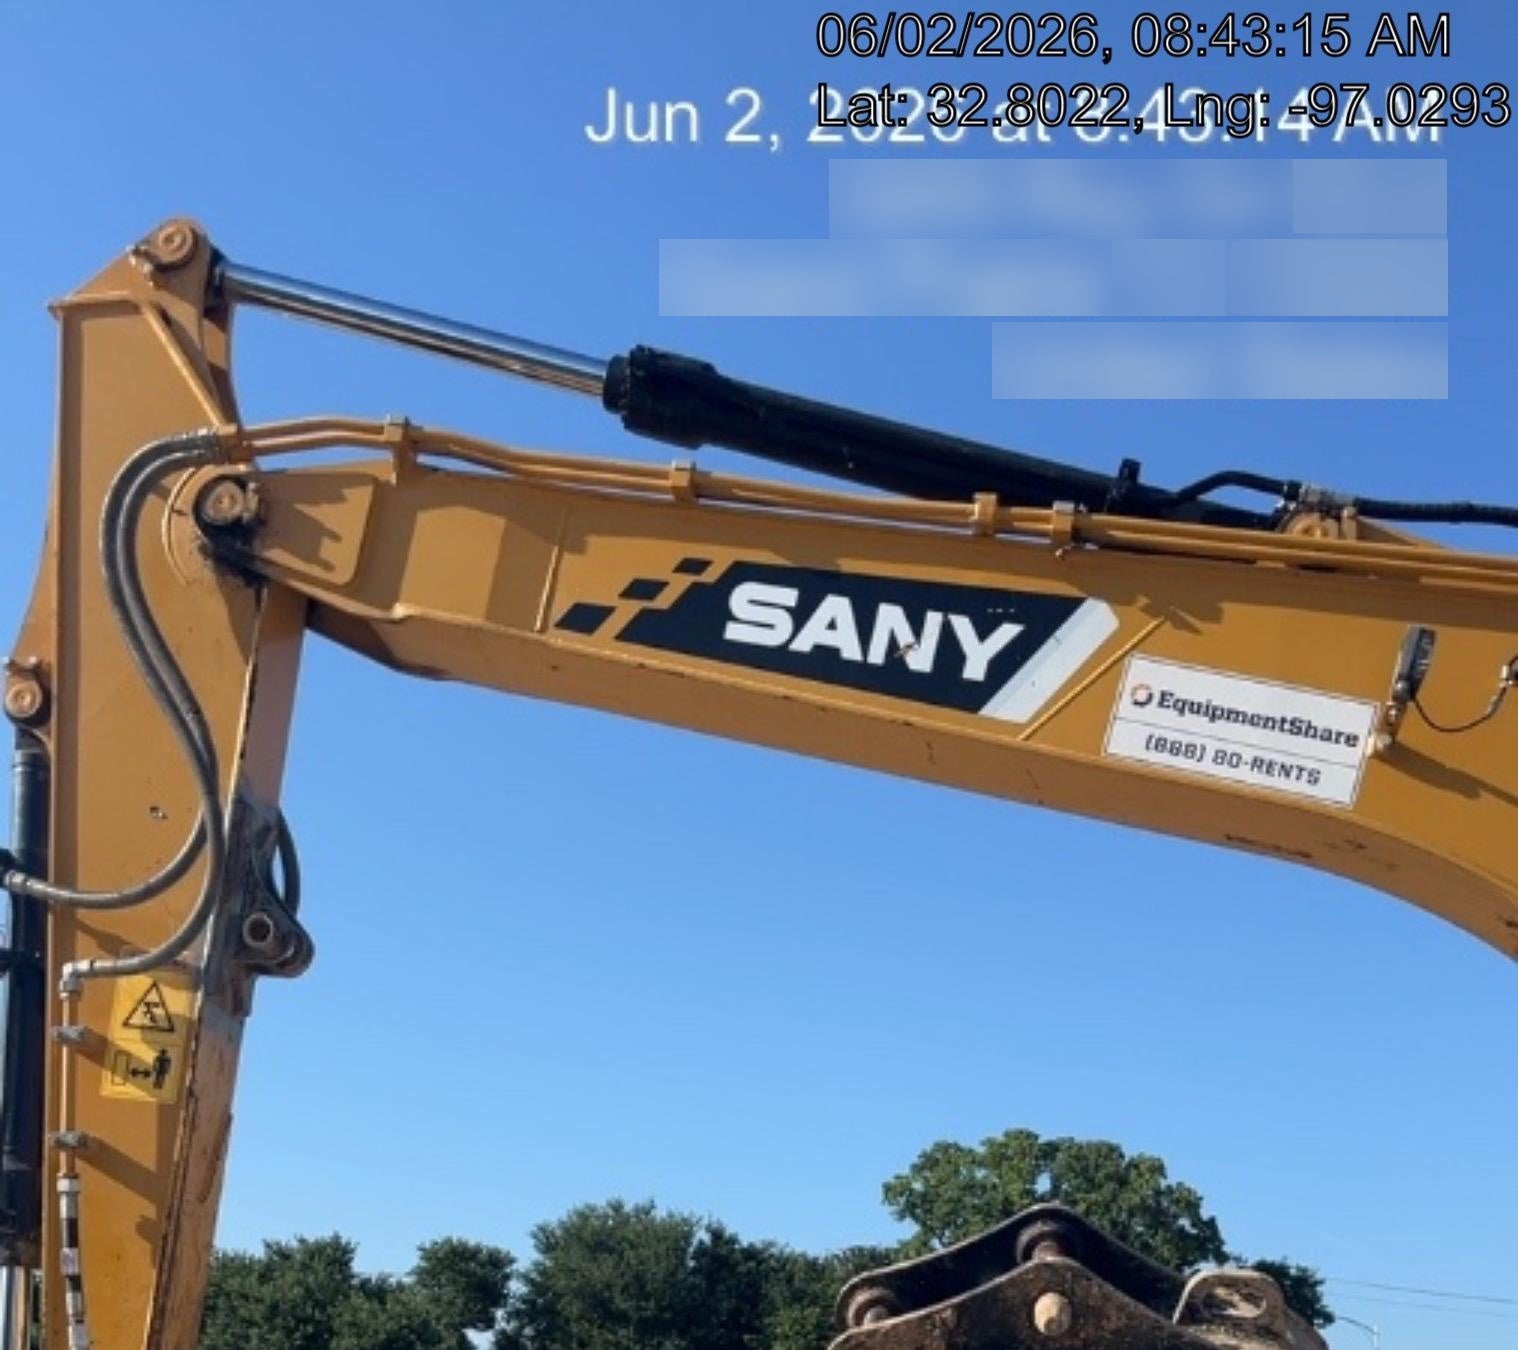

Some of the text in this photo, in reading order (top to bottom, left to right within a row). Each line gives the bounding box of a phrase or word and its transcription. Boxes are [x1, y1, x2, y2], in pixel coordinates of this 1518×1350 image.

[723, 581, 1026, 682] SANY
[1157, 689, 1360, 748] EquipmentShare
[1145, 733, 1321, 786] (888) 80-RENTS
